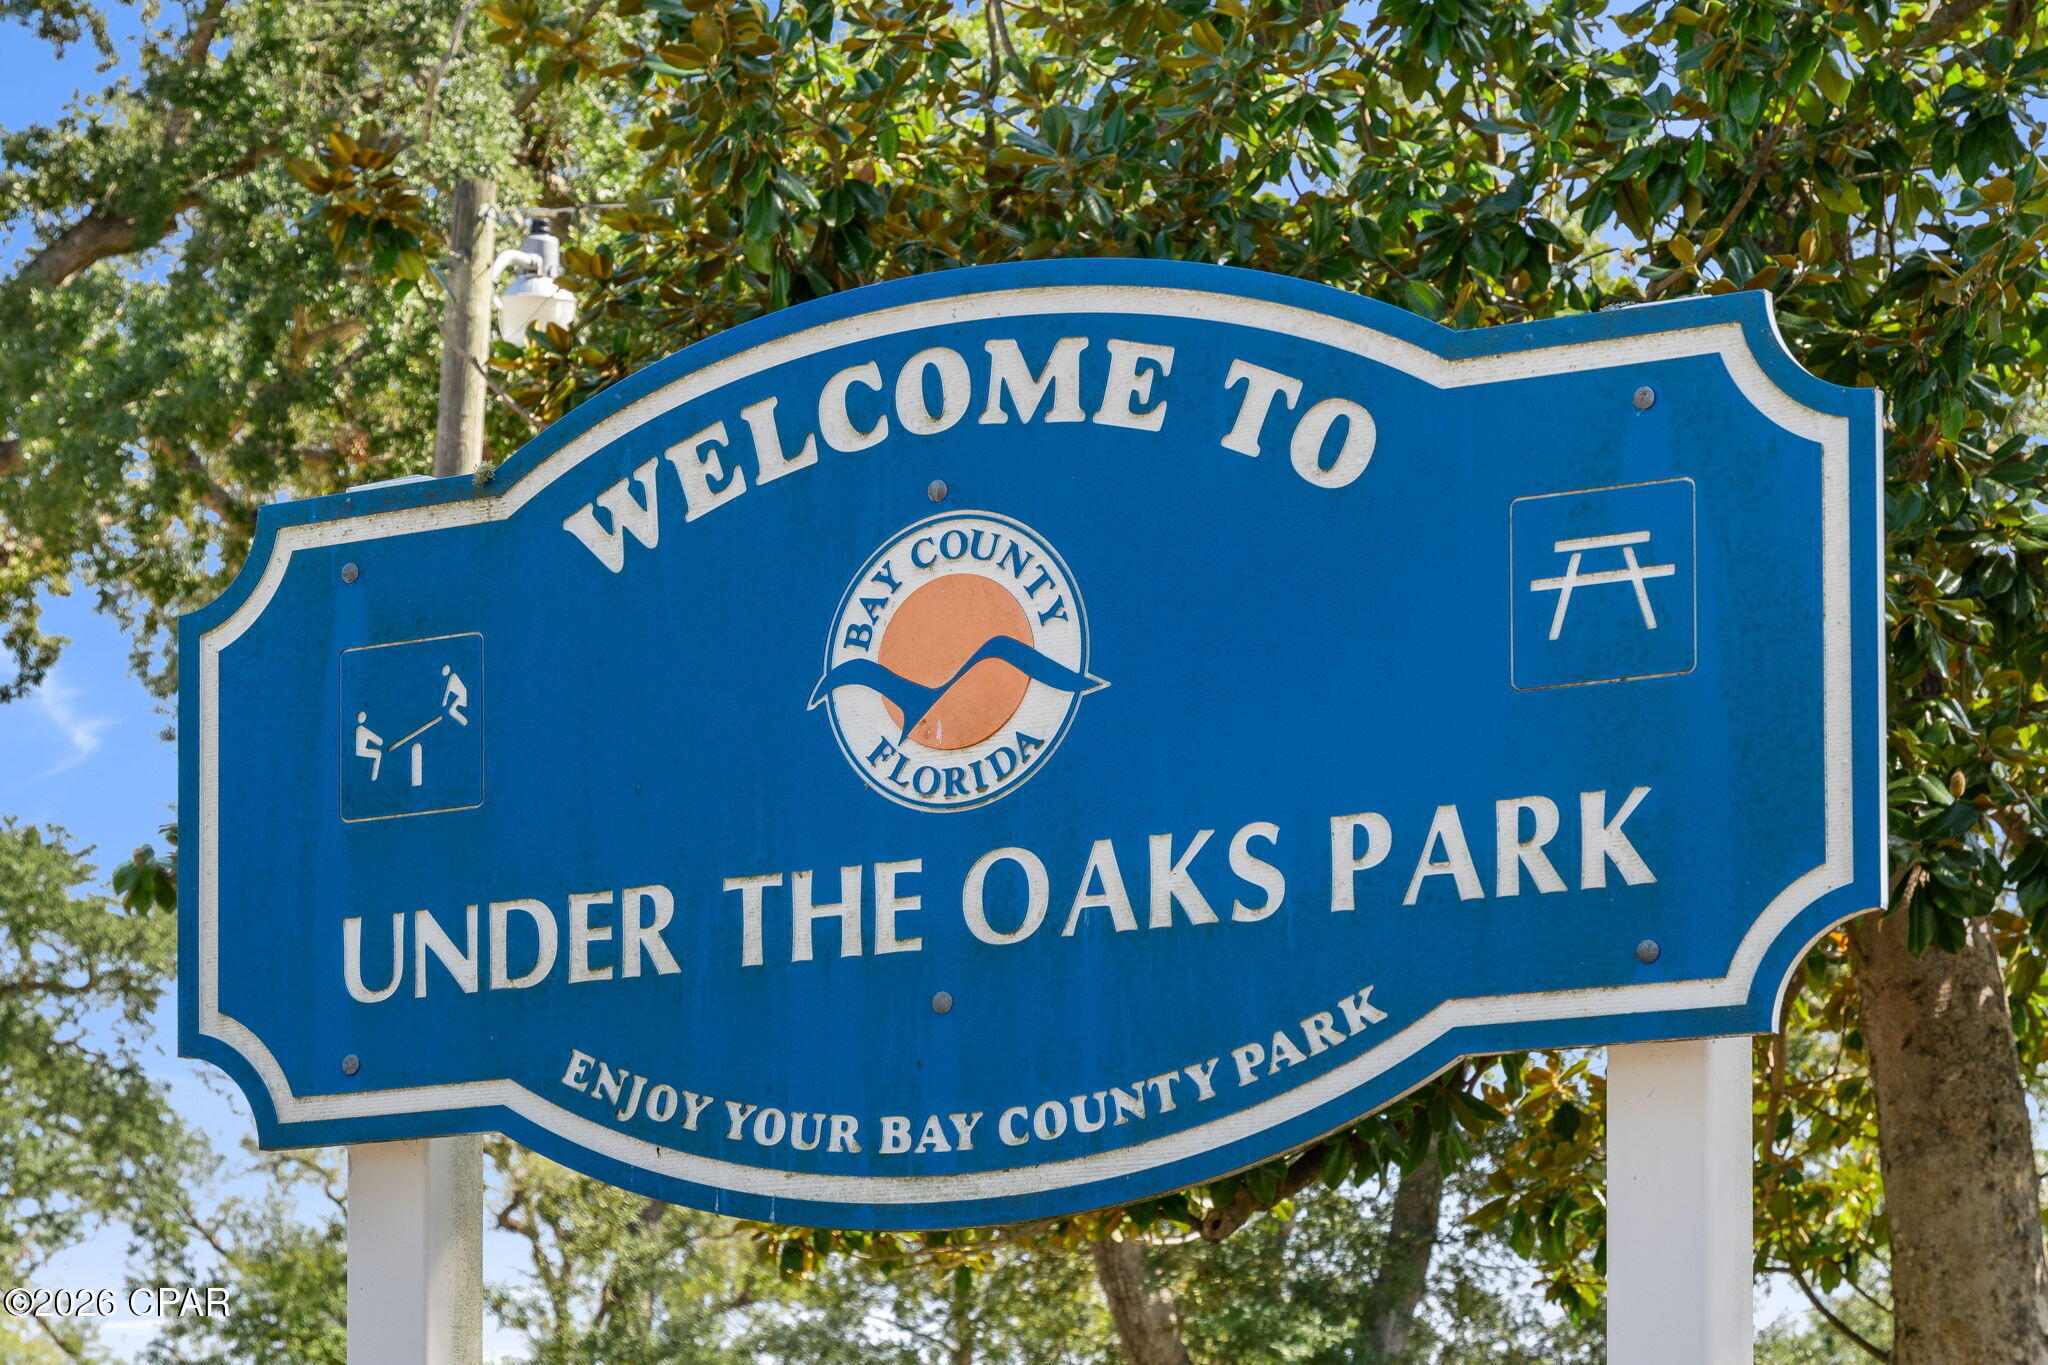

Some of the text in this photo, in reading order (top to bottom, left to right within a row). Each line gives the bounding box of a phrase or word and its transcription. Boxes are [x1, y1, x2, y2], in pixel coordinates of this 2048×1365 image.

[562, 336, 1378, 575] WELCOME TO
[843, 528, 1069, 652] BAY COUNTY
[865, 730, 1046, 800] FLORIDA
[342, 786, 1658, 1004] UNDER THE OAKS PARK
[561, 984, 1389, 1155] ENJOY YOUR BAY COUNTY PARK
